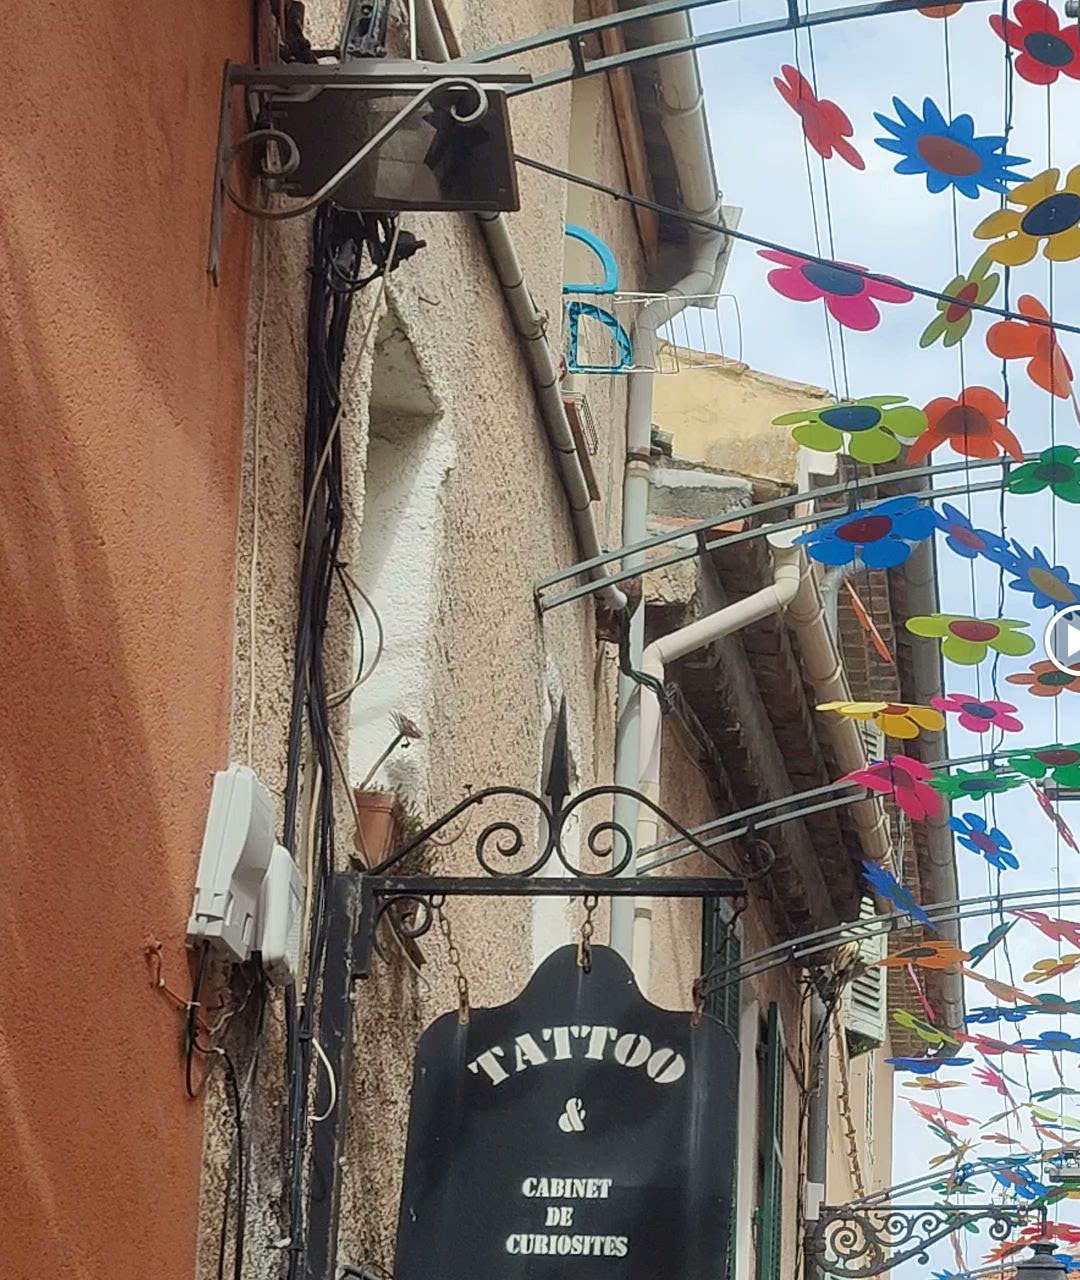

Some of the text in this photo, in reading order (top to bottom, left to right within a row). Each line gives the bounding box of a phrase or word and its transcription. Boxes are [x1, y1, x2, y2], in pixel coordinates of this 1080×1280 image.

[467, 1025, 686, 1086] TATTOO
[558, 1097, 586, 1133] &
[522, 1177, 612, 1198] CABINET
[545, 1206, 574, 1226] DE
[505, 1233, 629, 1257] CURIOSITES
